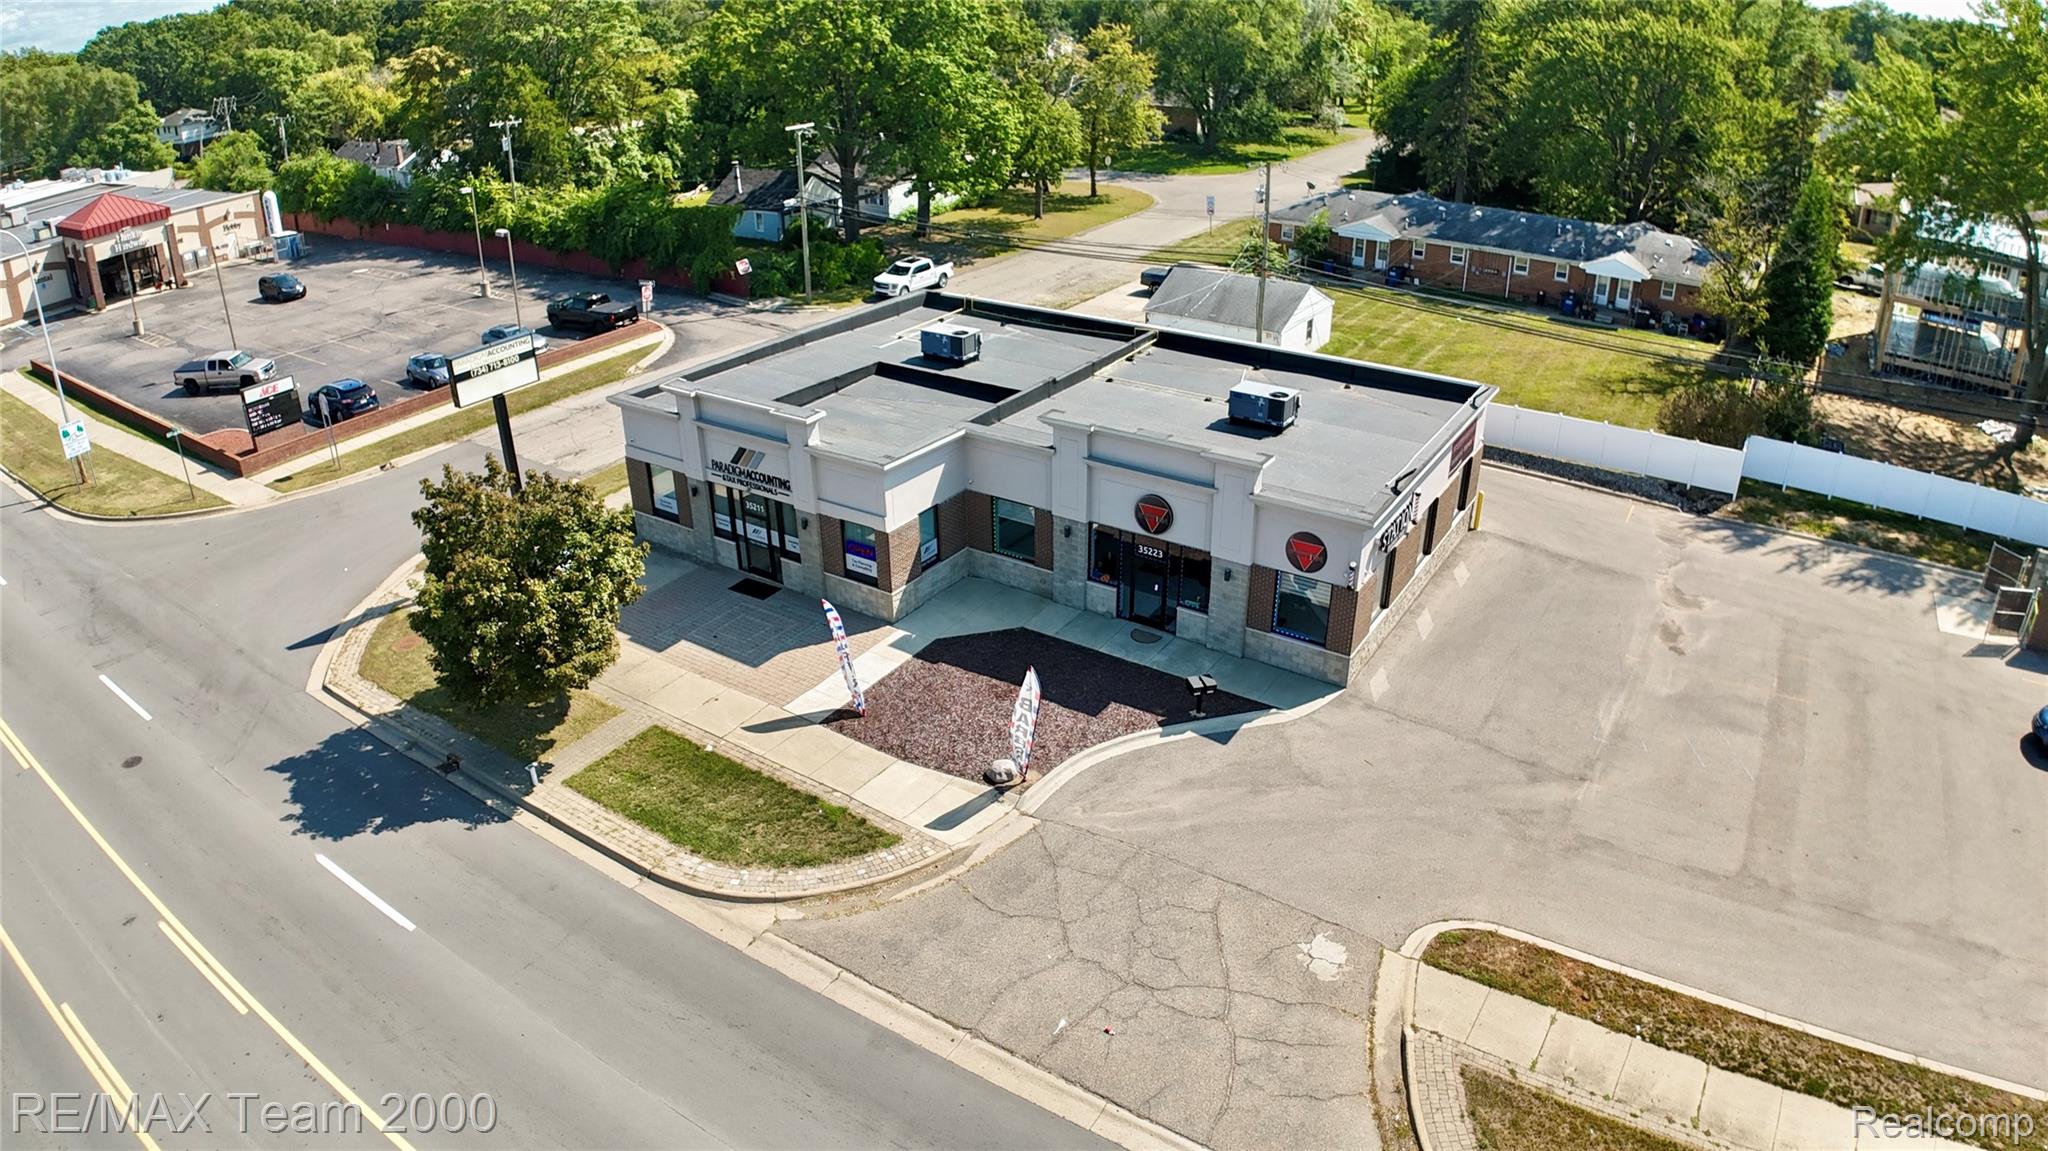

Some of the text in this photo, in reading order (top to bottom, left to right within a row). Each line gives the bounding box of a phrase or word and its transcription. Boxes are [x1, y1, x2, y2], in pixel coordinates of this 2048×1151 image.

[487, 338, 530, 357] ACCOUNTING
[470, 364, 488, 378] (734)
[489, 354, 520, 371] 713-8100
[711, 459, 791, 490] PARADIGM ACCOUNTING
[745, 501, 764, 512] 35211
[1137, 544, 1164, 559] 35223
